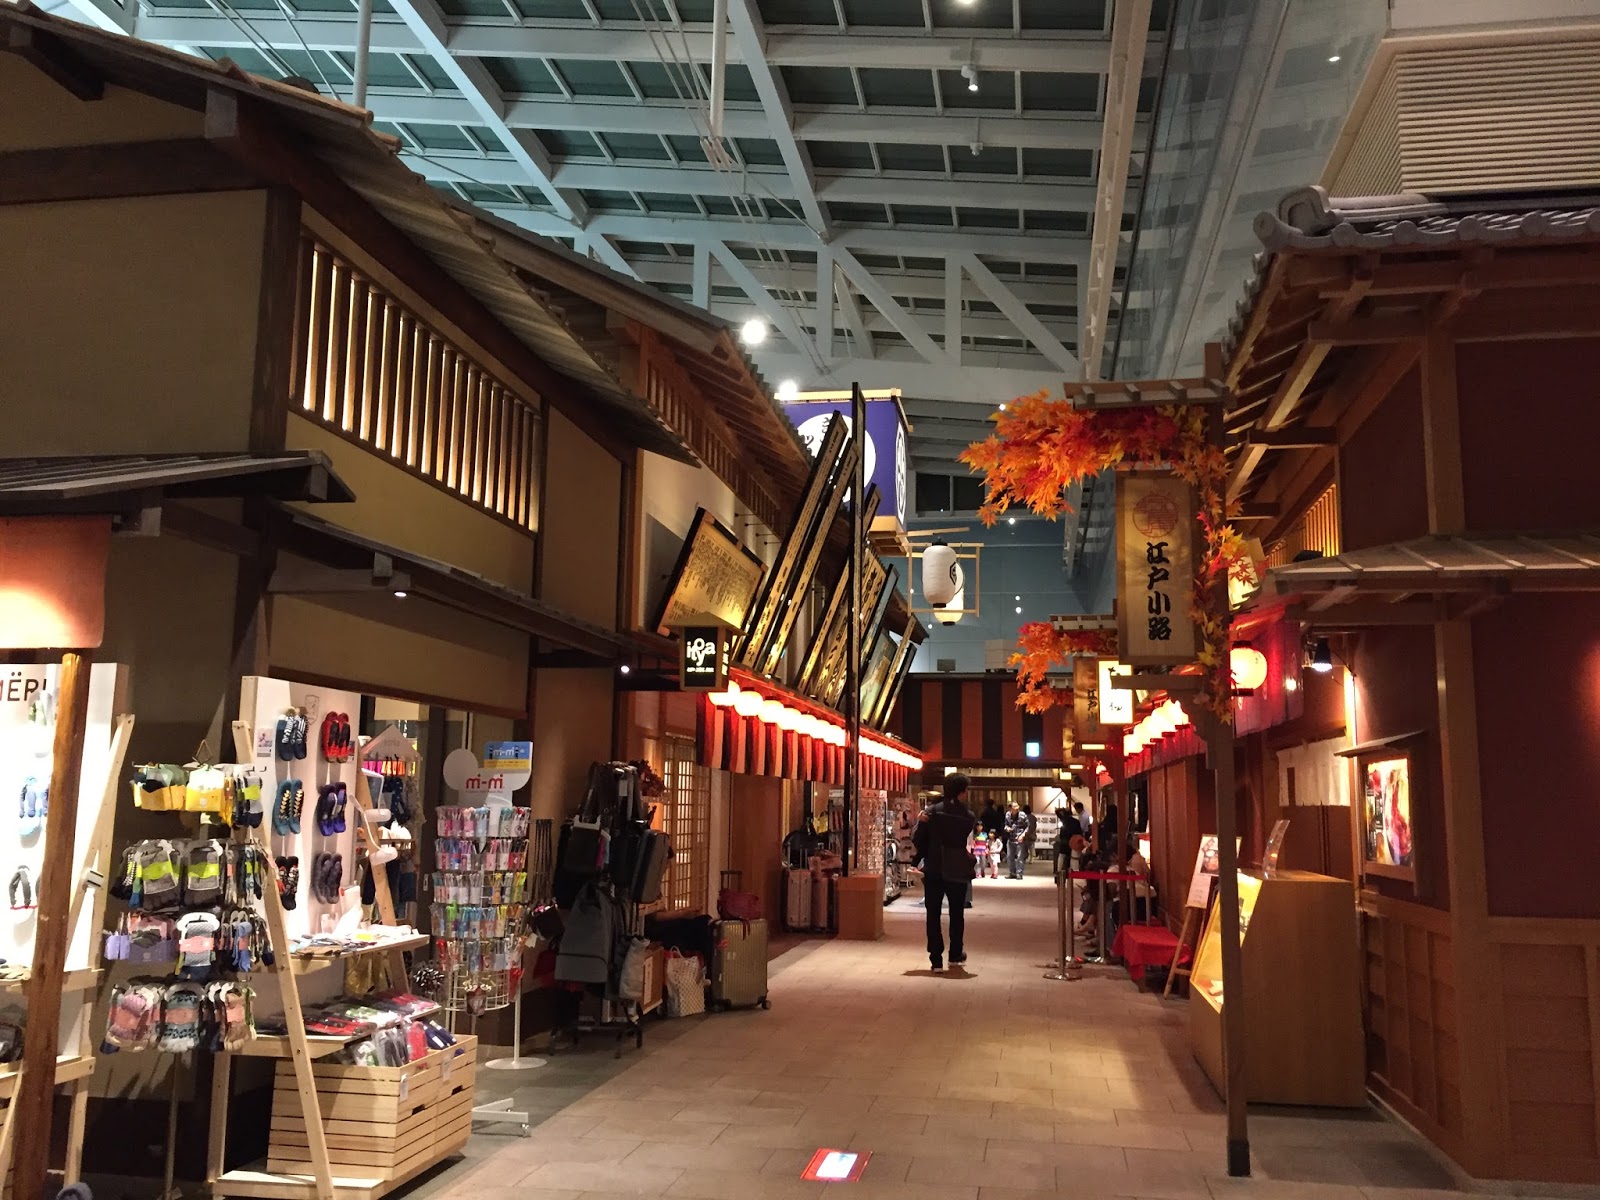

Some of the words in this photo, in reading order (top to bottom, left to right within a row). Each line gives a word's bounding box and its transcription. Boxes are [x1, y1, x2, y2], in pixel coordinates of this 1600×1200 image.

[1146, 541, 1172, 641] 江戸小路
[465, 773, 504, 789] mi-mi
